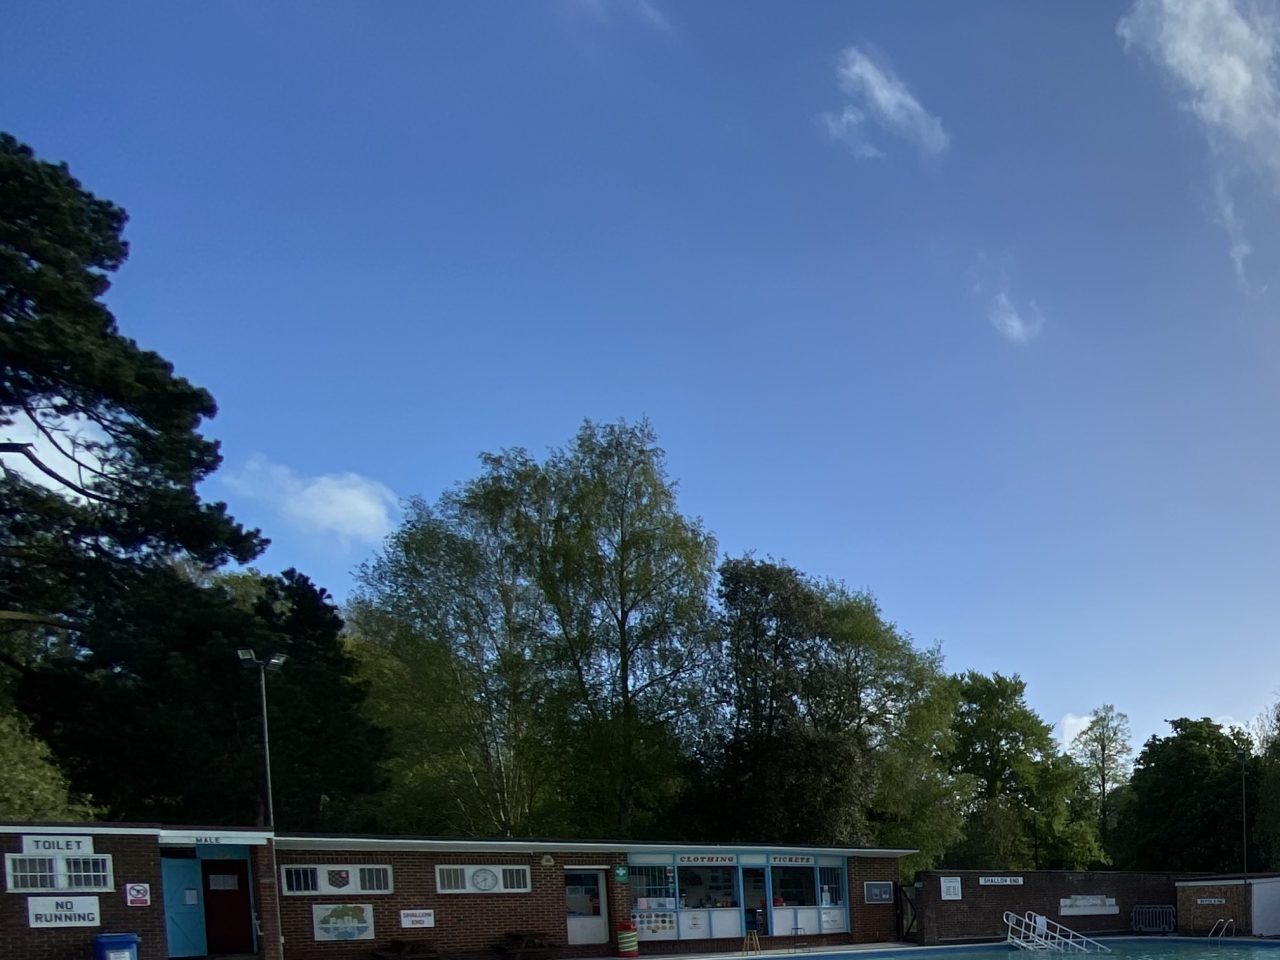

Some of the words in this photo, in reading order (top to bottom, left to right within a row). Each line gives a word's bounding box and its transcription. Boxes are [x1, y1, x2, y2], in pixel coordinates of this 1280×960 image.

[33, 840, 82, 850] TOILET
[55, 901, 74, 910] NO
[34, 912, 95, 923] RUNNING
